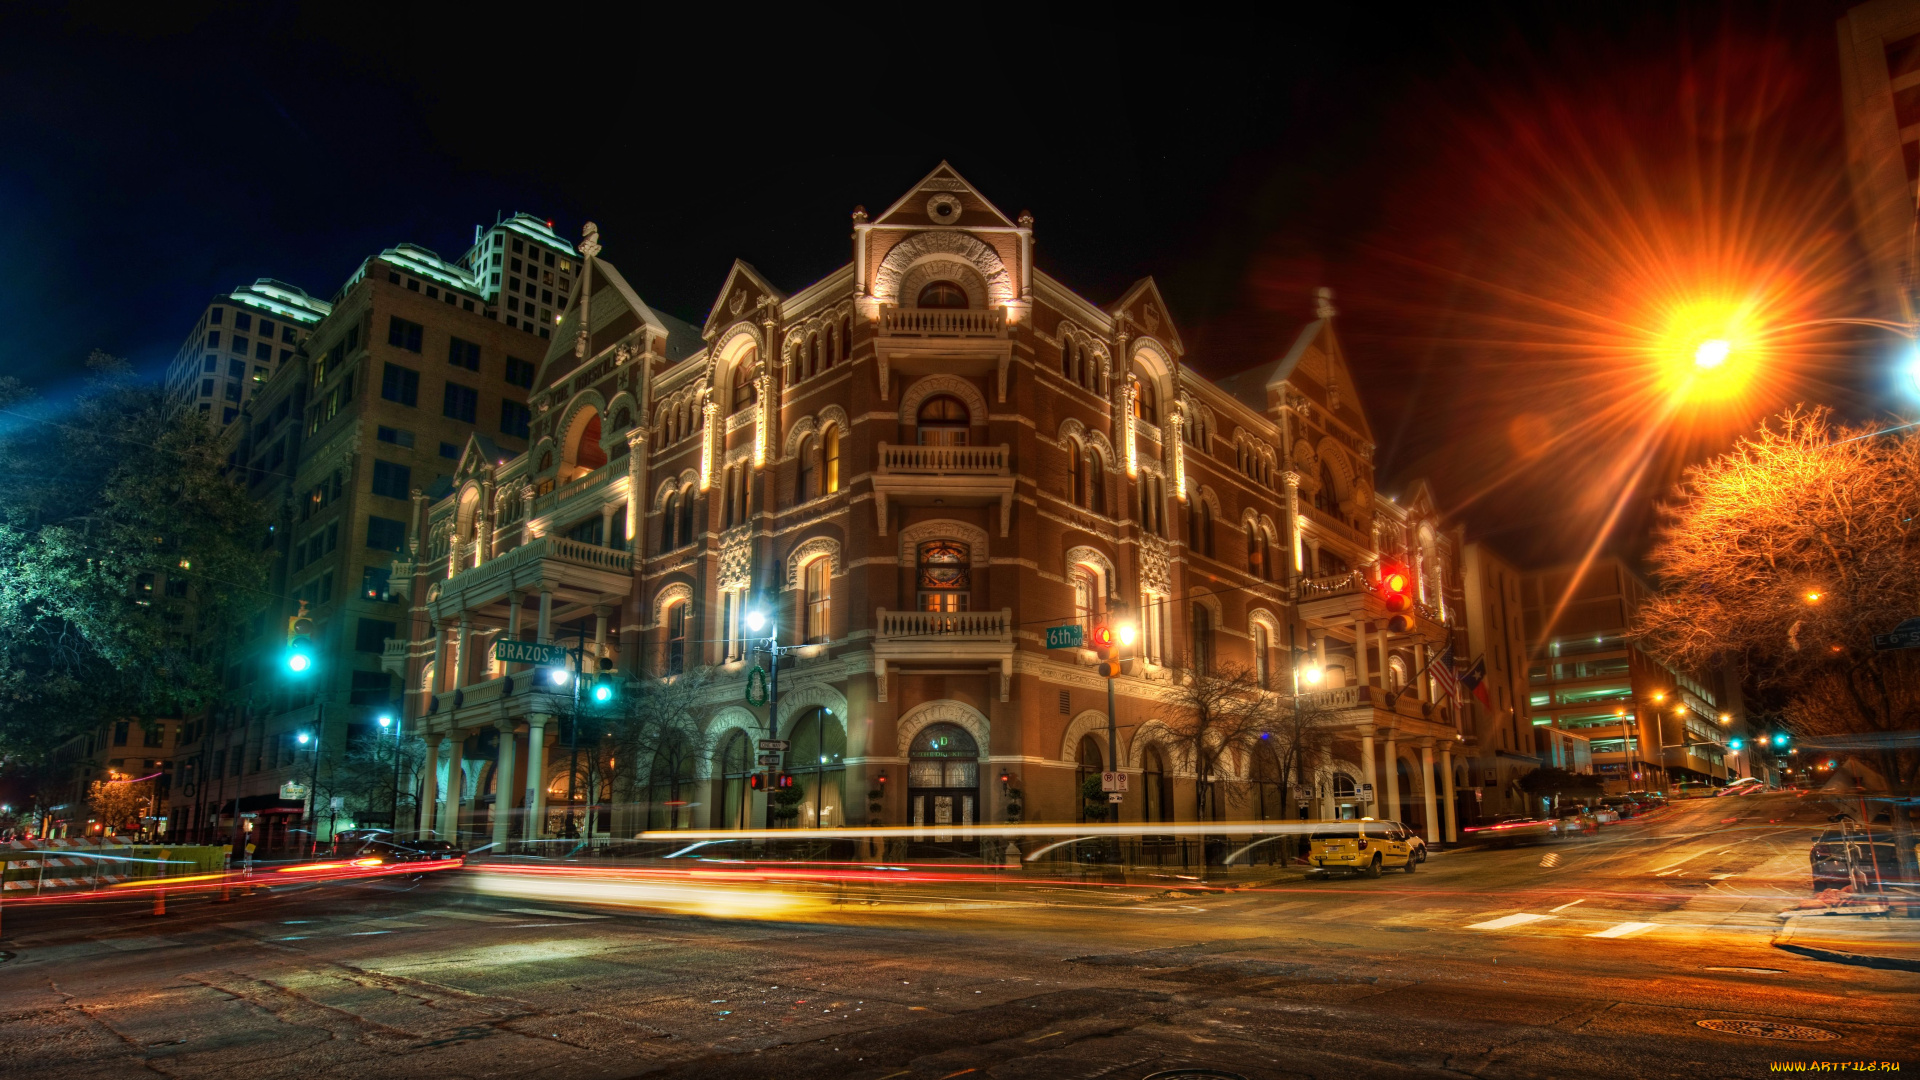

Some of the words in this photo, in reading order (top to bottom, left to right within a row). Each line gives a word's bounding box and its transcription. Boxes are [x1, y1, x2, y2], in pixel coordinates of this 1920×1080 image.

[1050, 630, 1070, 645] 6th
[1071, 637, 1082, 646] 100
[1876, 635, 1887, 645] E
[498, 643, 549, 662] BRAZOS
[550, 658, 565, 666] 600
[941, 737, 948, 745] D
